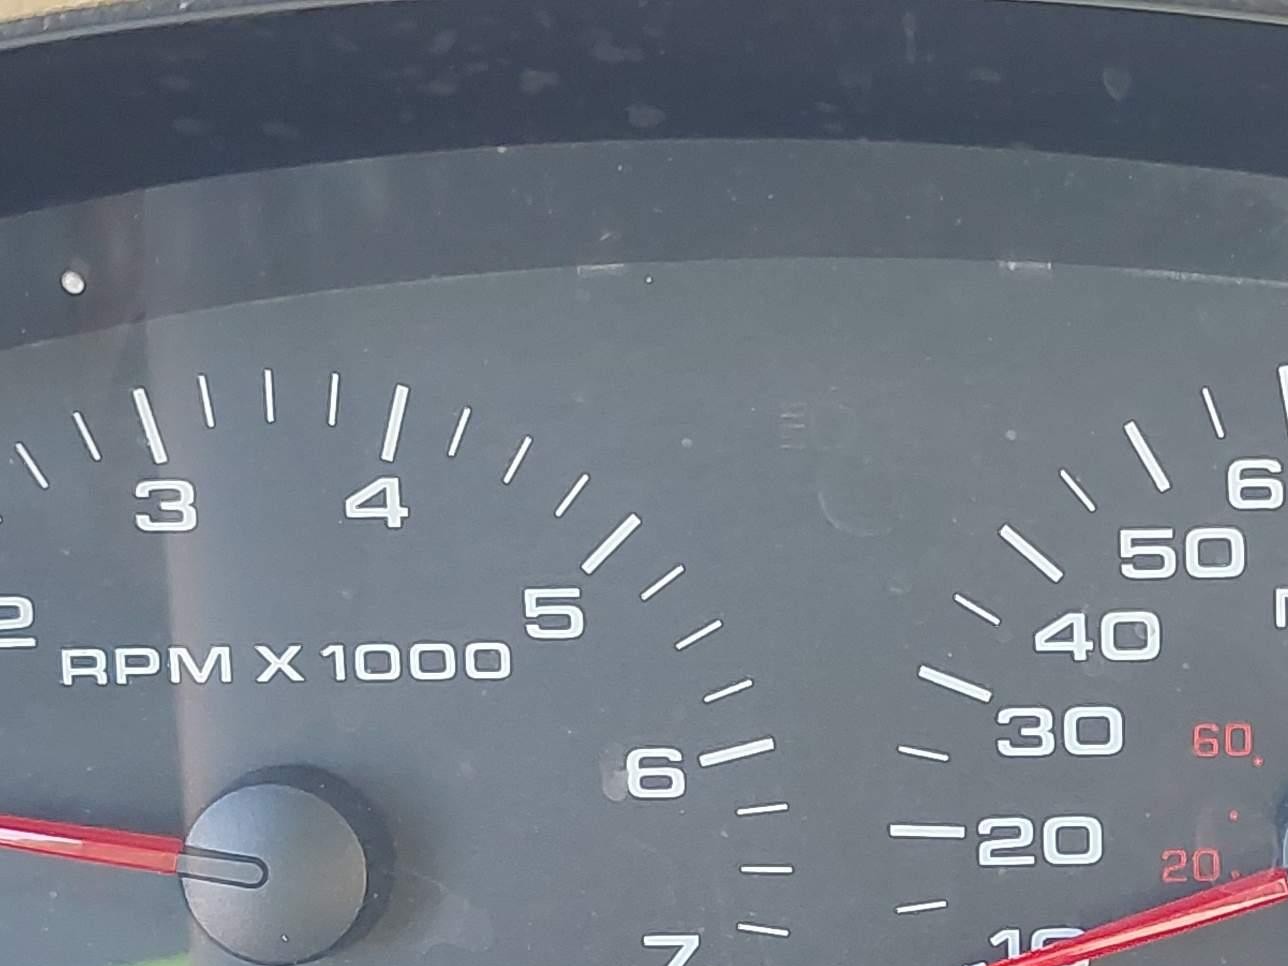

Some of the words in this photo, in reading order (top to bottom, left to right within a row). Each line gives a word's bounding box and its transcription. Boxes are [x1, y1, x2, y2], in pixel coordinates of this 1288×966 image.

[134, 480, 198, 532] 3
[344, 477, 410, 528] 4
[1119, 527, 1246, 579] 50
[0, 596, 37, 648] 2
[523, 588, 585, 640] 5
[1034, 611, 1161, 662] 40
[60, 645, 233, 687] RPM
[255, 645, 305, 683] X
[320, 642, 512, 681] 1000
[996, 706, 1124, 757] 30
[1192, 722, 1253, 758] 60
[626, 748, 687, 800] 6
[977, 816, 1103, 866] 20
[1160, 848, 1221, 884] 20
